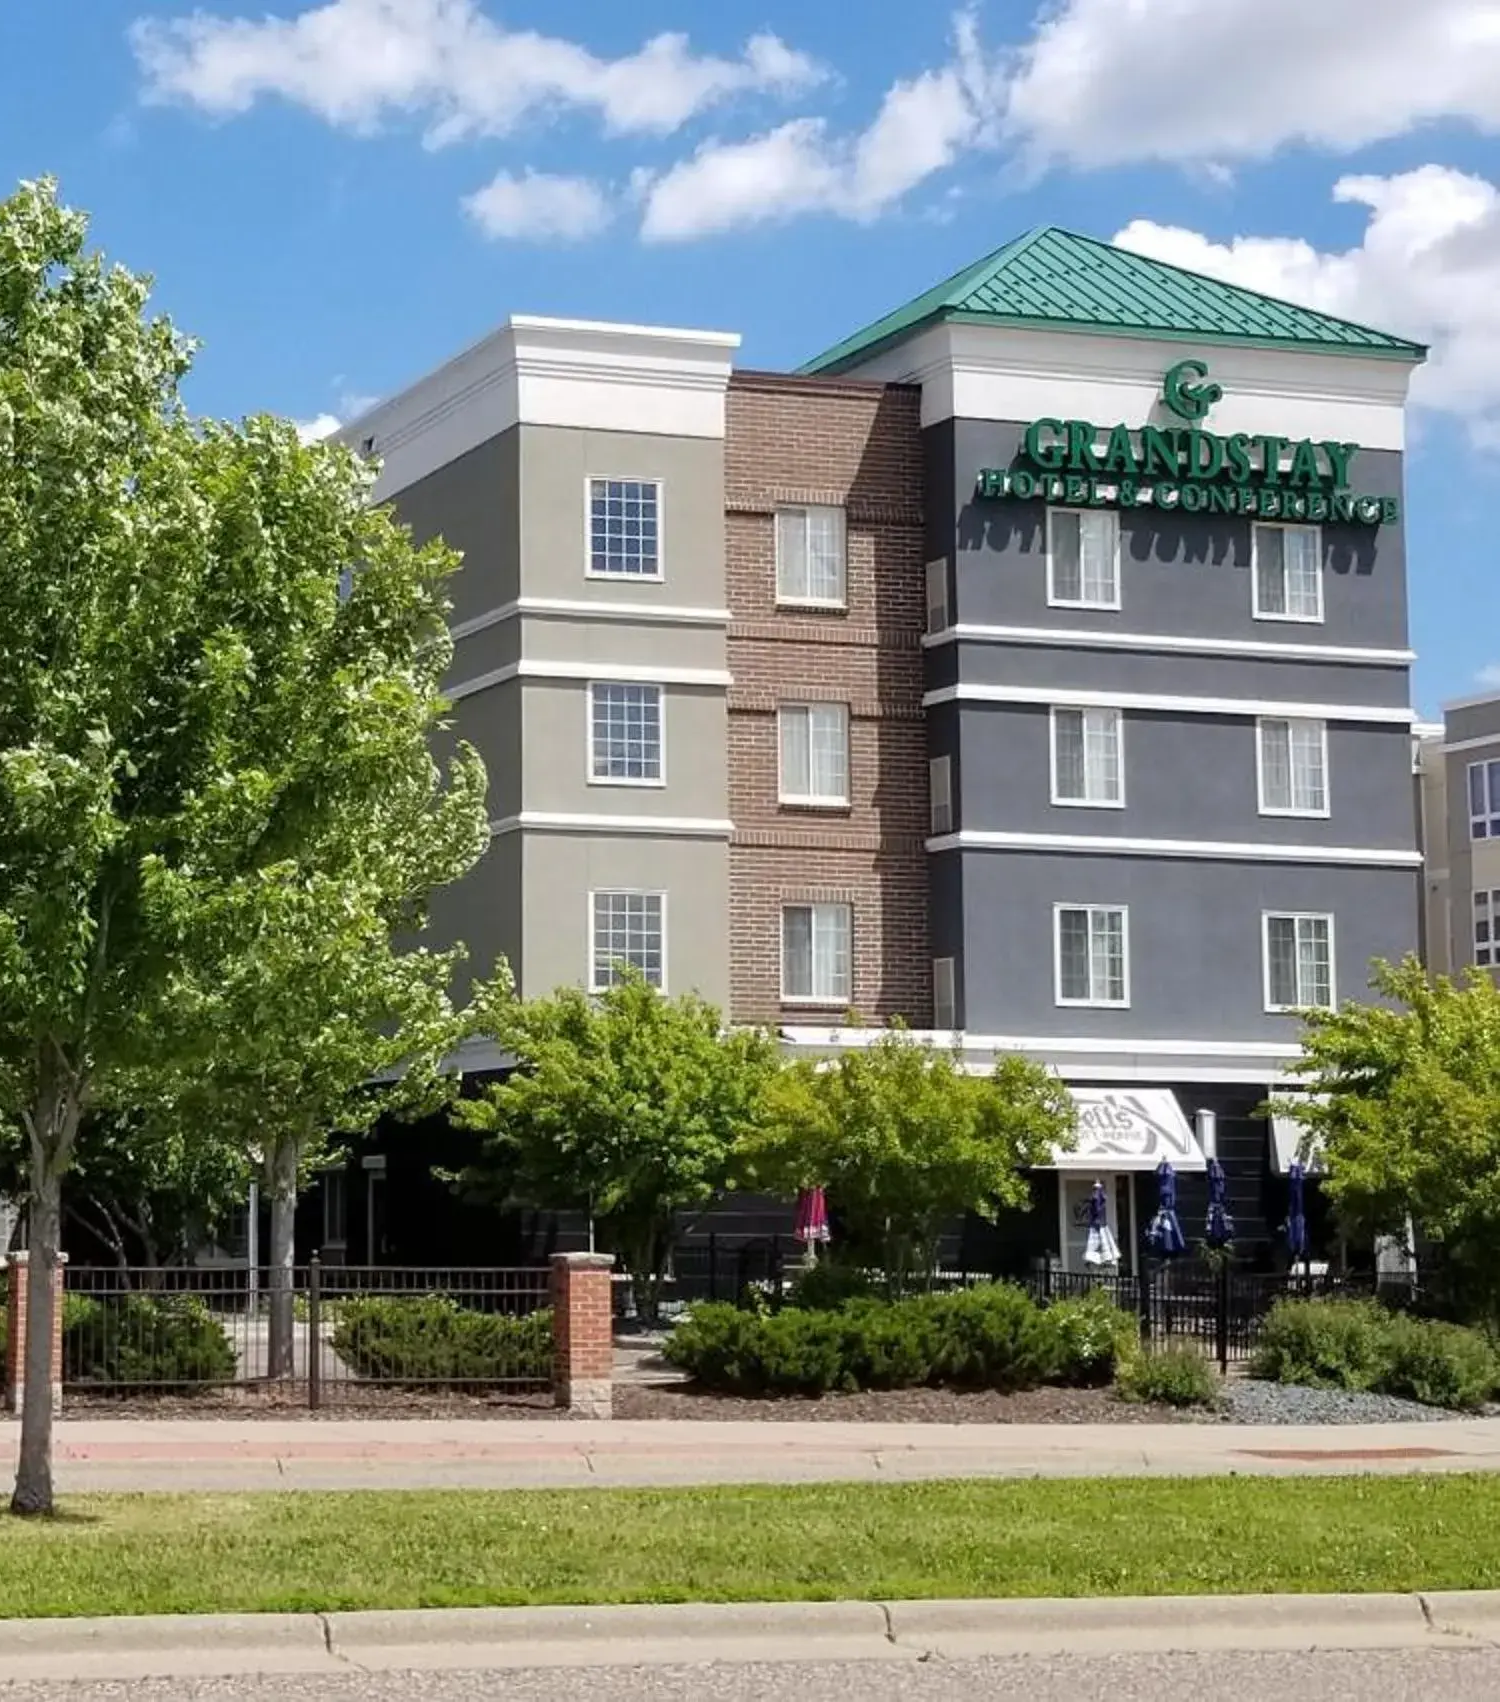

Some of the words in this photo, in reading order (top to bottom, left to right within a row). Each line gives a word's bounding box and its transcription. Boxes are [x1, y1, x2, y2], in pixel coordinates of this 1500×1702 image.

[1024, 417, 1361, 490] GRANDSTAY
[979, 468, 1107, 505] HOTEL
[1119, 479, 1140, 507] &
[1153, 481, 1399, 525] CONFERENCE
